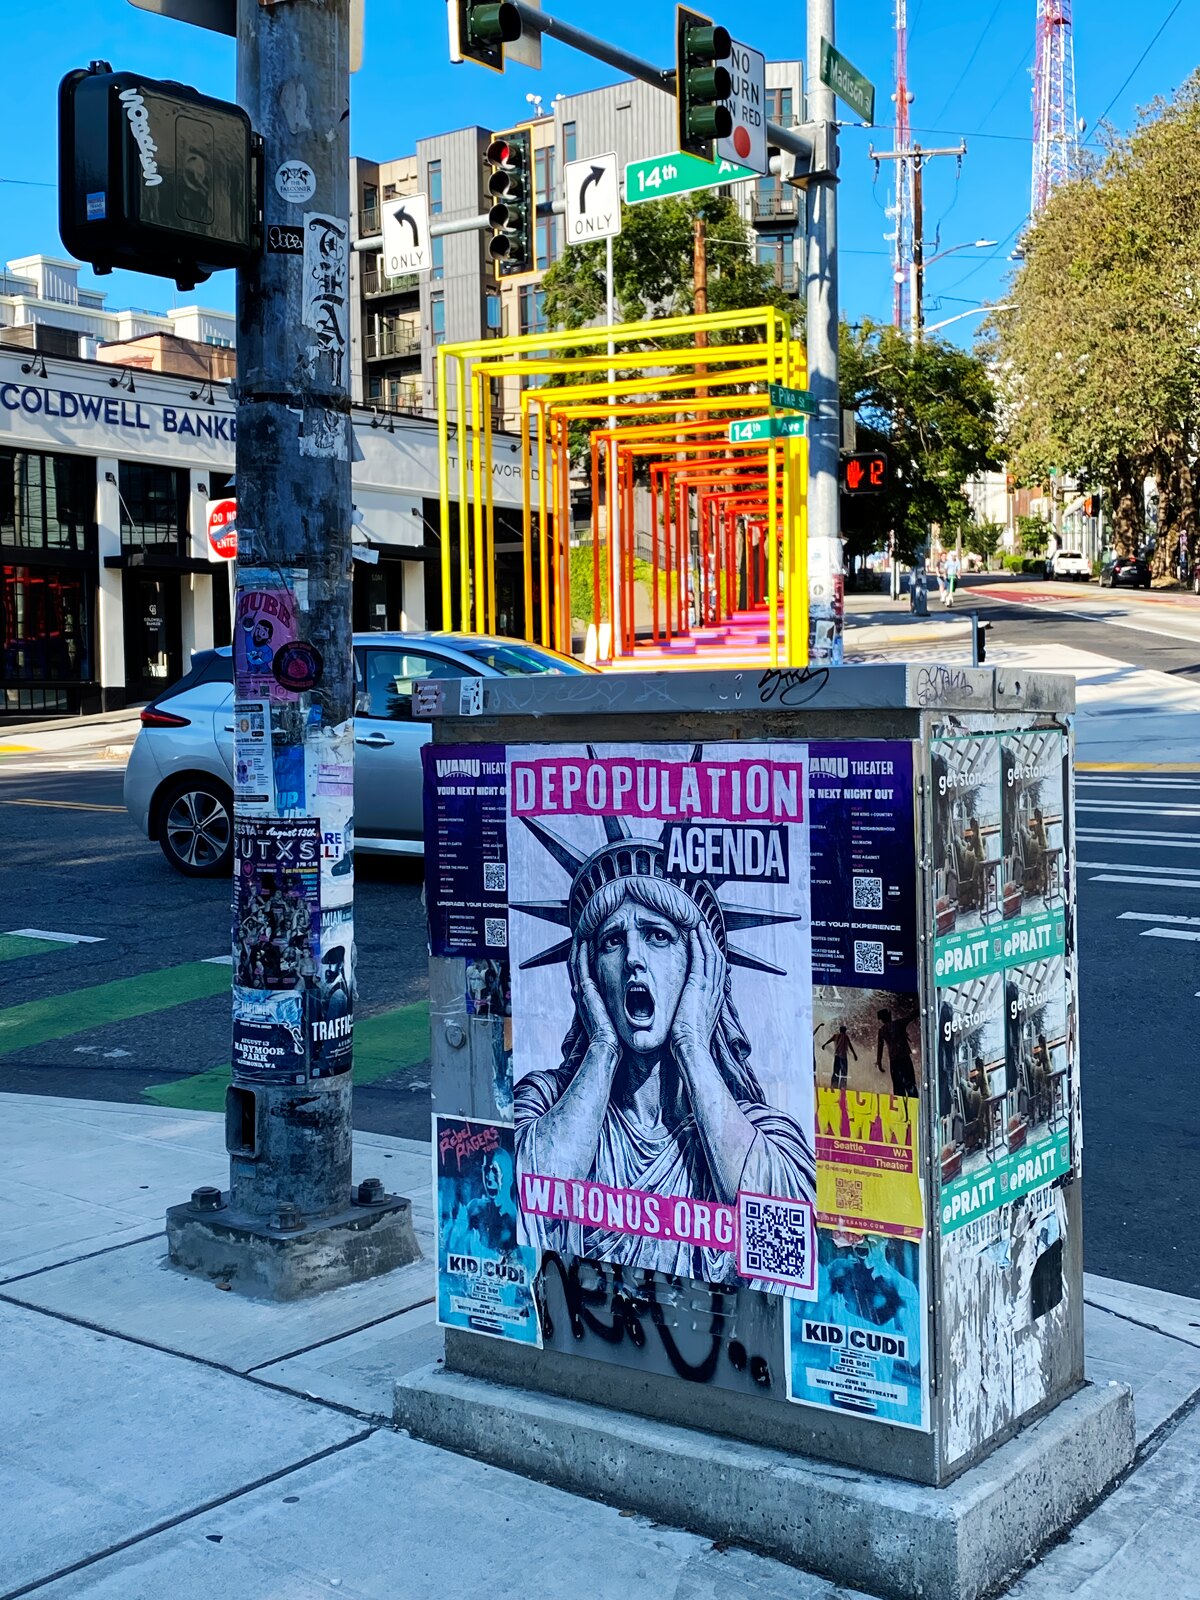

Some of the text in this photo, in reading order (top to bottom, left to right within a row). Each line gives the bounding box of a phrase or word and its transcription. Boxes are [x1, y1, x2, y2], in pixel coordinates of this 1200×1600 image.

[731, 47, 750, 74] NO
[730, 76, 760, 106] URN
[830, 56, 864, 107] Madison
[742, 108, 762, 128] RED
[637, 163, 678, 192] 14th
[575, 213, 613, 236] ONLY
[391, 250, 424, 270] ONLY
[772, 388, 805, 408] E Pike St
[0, 384, 236, 442] COLDWELL BANKE
[734, 422, 800, 440] 14th Ave
[870, 460, 884, 485] 12
[213, 511, 237, 524] DO NO
[217, 537, 236, 549] ENTE
[436, 759, 506, 778] WAMU THEAT
[809, 757, 894, 778] AMU THEATER
[1007, 760, 1024, 787] get
[437, 786, 456, 796] YOUR
[457, 786, 475, 796] NEXT
[476, 786, 498, 796] NIGHT
[515, 764, 798, 817] DEPOPULATION
[817, 788, 841, 799] NEXT
[843, 789, 872, 800] NIGHT
[874, 789, 894, 800] OUT
[939, 769, 958, 796] get
[277, 792, 298, 809] UP
[266, 827, 297, 839] August
[667, 827, 787, 877] AGENDA
[828, 921, 849, 929] YOUR
[851, 923, 902, 932] EXPERIENCE
[1004, 924, 1052, 957] @PRATT
[936, 940, 989, 977] @PRATT
[1010, 990, 1027, 1020] get
[944, 1011, 963, 1042] get
[235, 1041, 285, 1056] MARYMOOR
[243, 1051, 268, 1062] PARK
[834, 1141, 908, 1158] Seattle, WA
[875, 1159, 908, 1172] Theater
[1009, 1147, 1057, 1191] @PRATT
[525, 1175, 733, 1244] WARONUS.ORG
[942, 1177, 996, 1224] @PRATT
[449, 1256, 525, 1285] KID CUDI
[805, 1322, 843, 1344] KID
[849, 1329, 905, 1358] CUDI
[840, 1357, 854, 1365] BIG
[815, 1378, 898, 1400] WHITE RIVER AMPHITHEATRE
